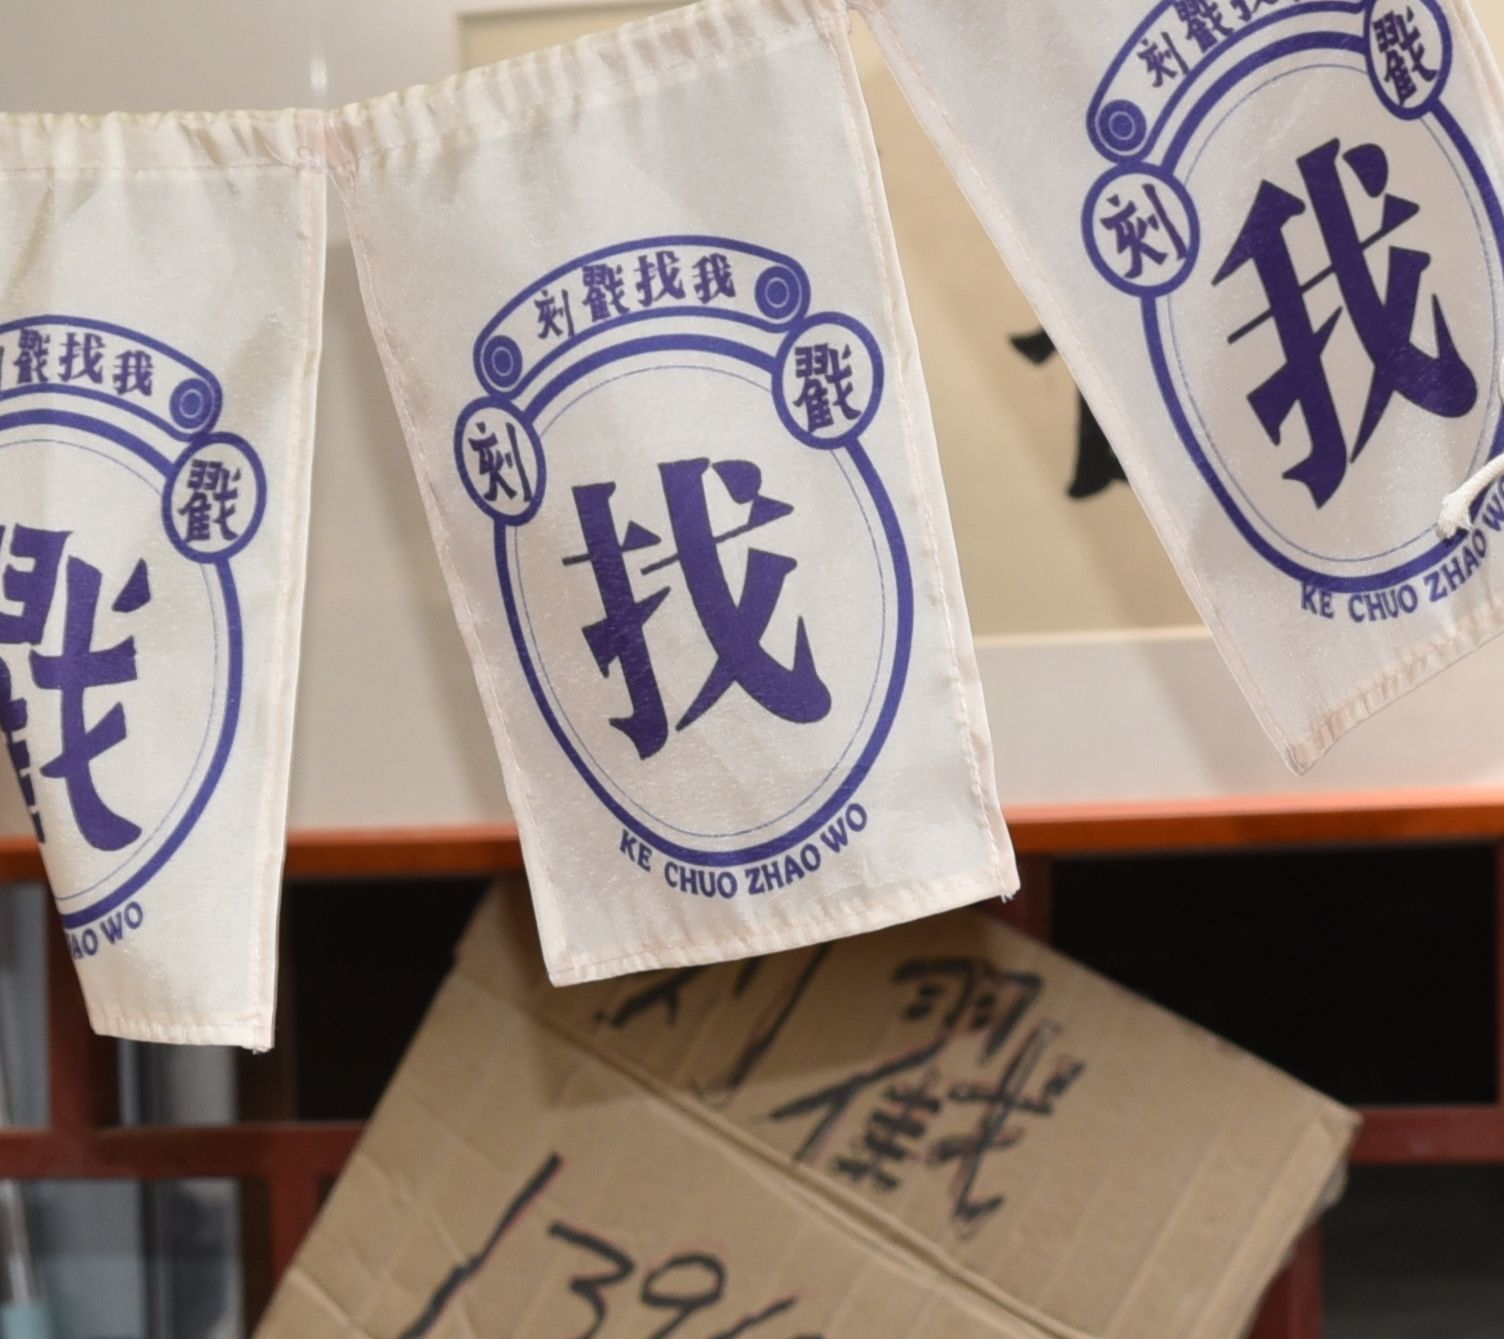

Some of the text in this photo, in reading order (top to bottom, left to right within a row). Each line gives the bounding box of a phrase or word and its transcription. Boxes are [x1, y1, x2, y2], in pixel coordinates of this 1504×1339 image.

[1372, 5, 1439, 106] 戳
[1099, 183, 1190, 279] 刻
[533, 250, 737, 340] 刻戳找我
[1209, 136, 1477, 510] 我
[793, 343, 862, 433] 戳
[178, 459, 242, 542] 戳
[468, 422, 532, 502] 刻
[562, 458, 832, 760] 找
[1300, 583, 1334, 619] KE
[1348, 584, 1419, 622] CHUO
[1423, 528, 1487, 603] ZHAO
[619, 803, 868, 899] KE CHUO ZHAO WO
[101, 899, 144, 944] WO
